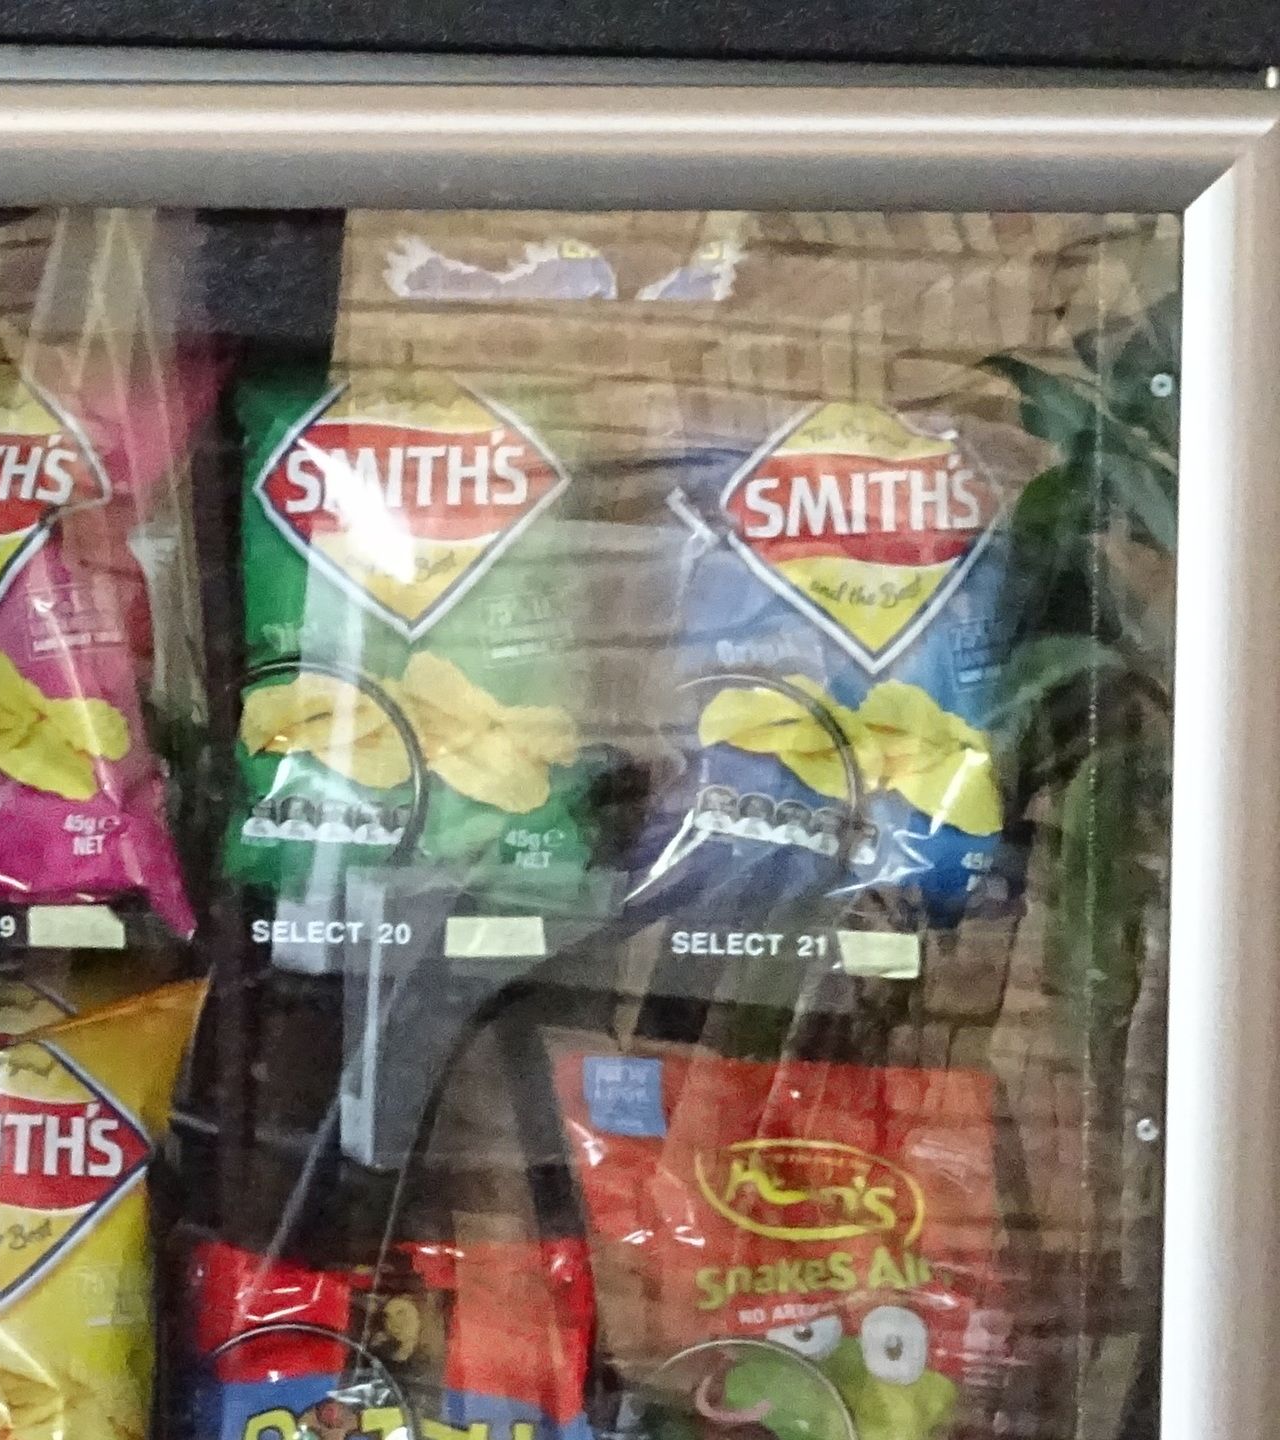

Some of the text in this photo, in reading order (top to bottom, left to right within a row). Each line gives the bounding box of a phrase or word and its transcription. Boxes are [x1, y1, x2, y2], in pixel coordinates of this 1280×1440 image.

[745, 454, 978, 538] SMITH'S
[251, 921, 412, 945] SELECT 20
[671, 931, 827, 956] SELECT 21
